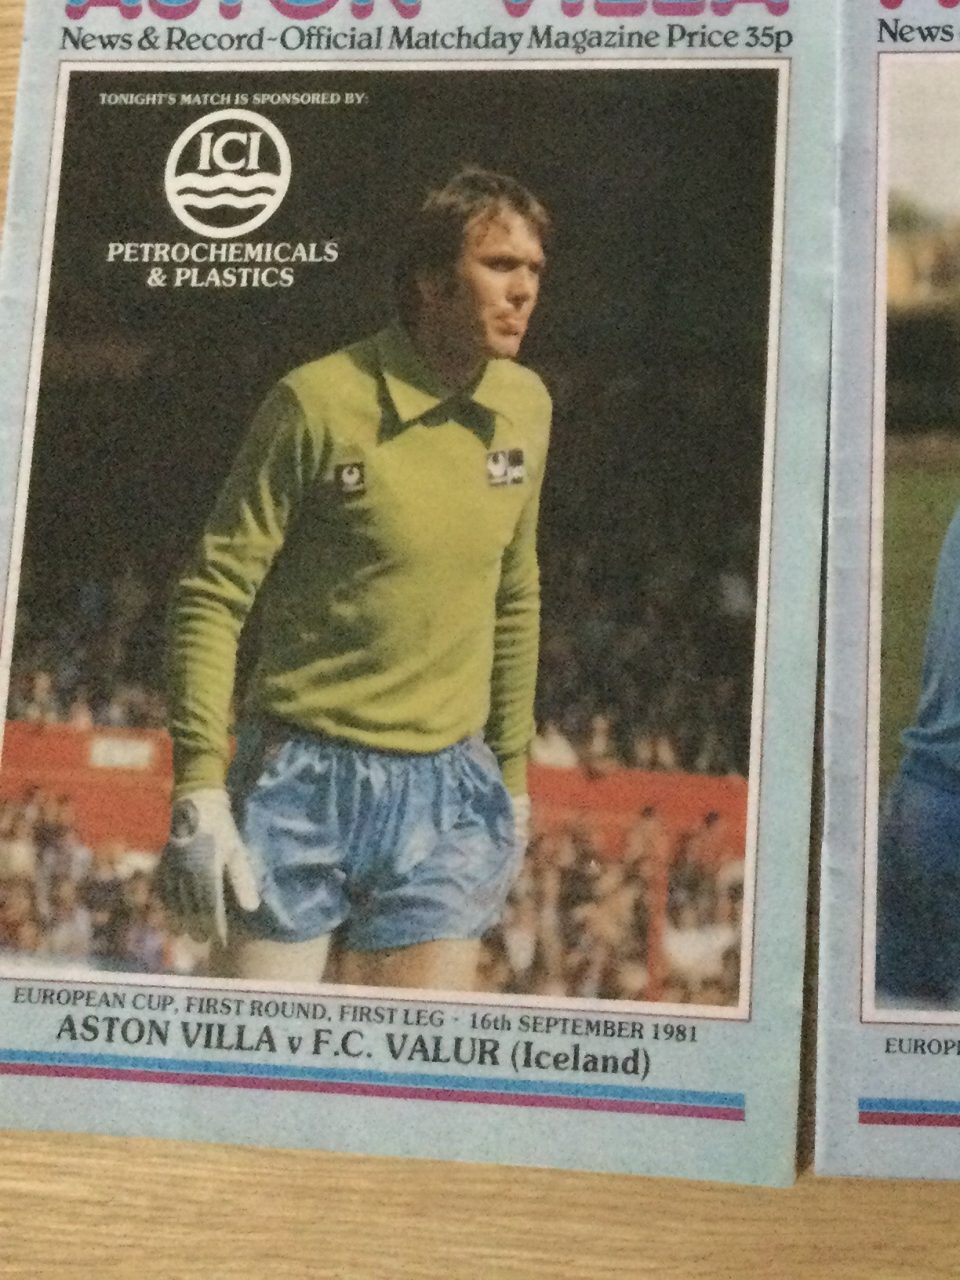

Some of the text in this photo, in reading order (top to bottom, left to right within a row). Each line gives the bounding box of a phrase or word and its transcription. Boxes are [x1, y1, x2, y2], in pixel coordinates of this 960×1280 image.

[60, 25, 133, 51] News
[137, 26, 160, 51] &
[390, 25, 523, 55] Matchday
[529, 25, 660, 54] Magazine
[667, 24, 739, 49] Price
[745, 25, 793, 53] 35p
[877, 17, 955, 43] News
[99, 92, 177, 106] TONIGHT'S
[180, 93, 232, 106] MATCH
[234, 93, 250, 106] IS
[252, 92, 342, 106] SPONSORED
[197, 131, 263, 171] ICI
[106, 242, 340, 263] PETROCHEMICALS
[147, 267, 295, 288] & PLASTICS
[12, 986, 698, 1043] EUROPEAN CUP, FIRST ROUND, FIRST LEG 16th SEPTEMBER 1981
[56, 1013, 652, 1081] ASTON VILLA v F.C. VALUR (Iceland)
